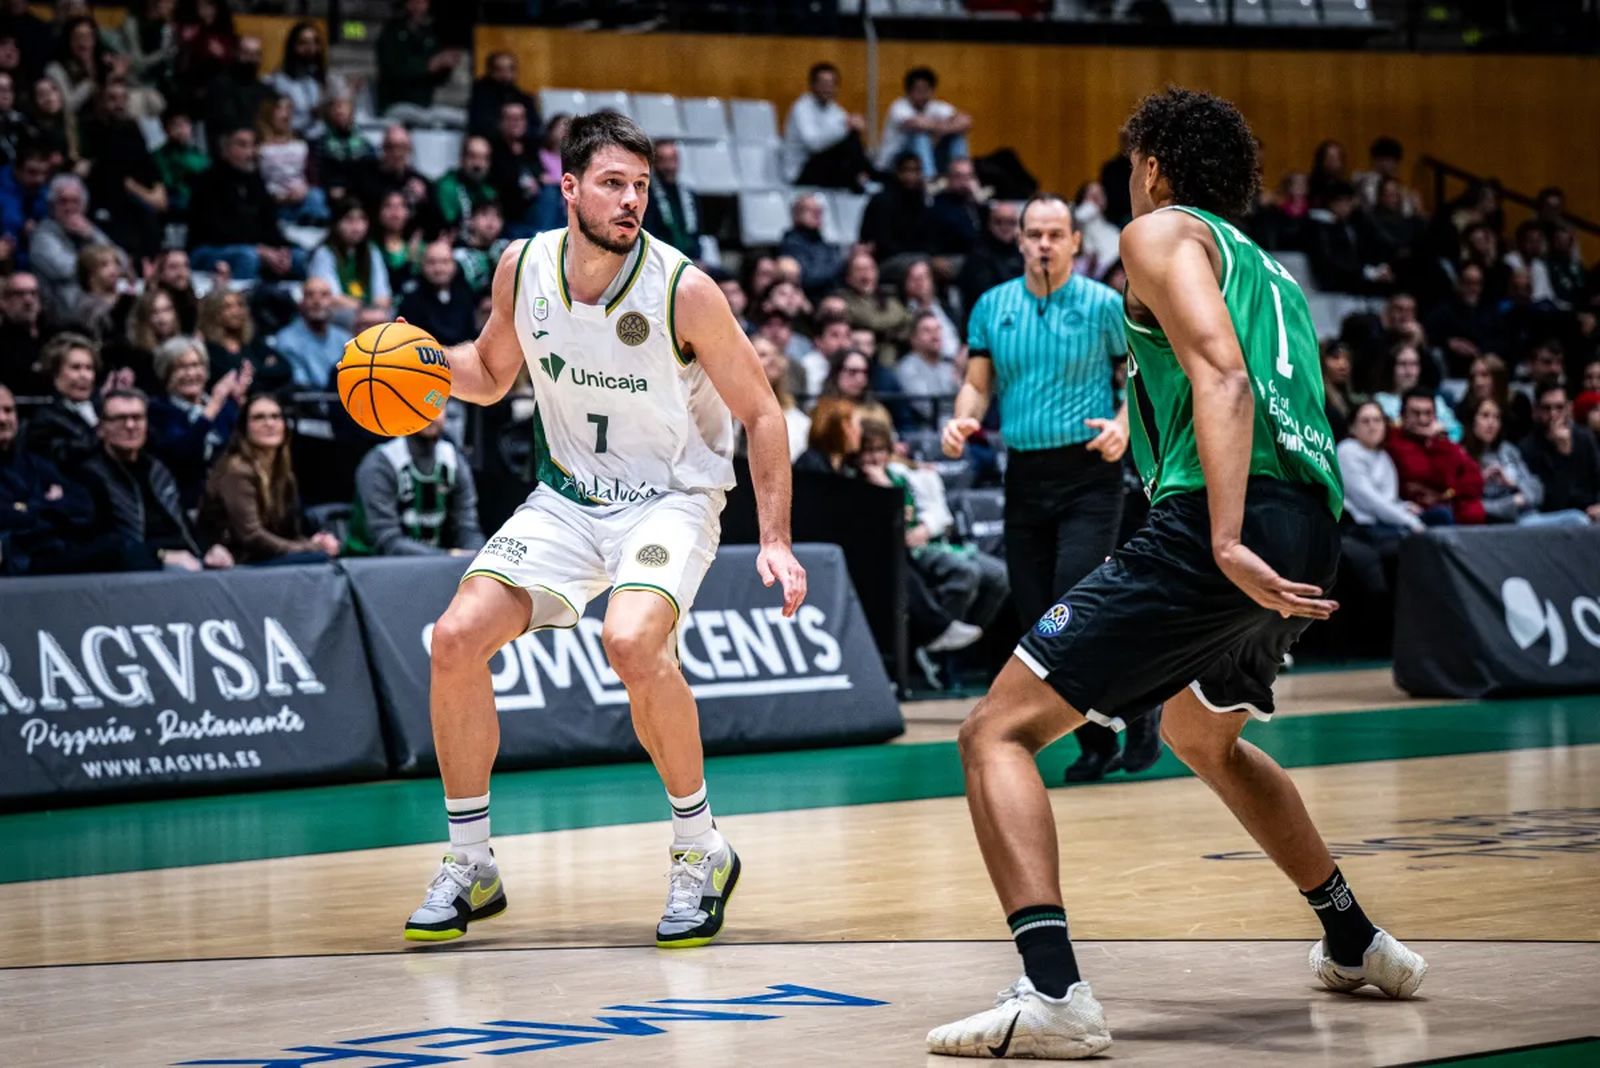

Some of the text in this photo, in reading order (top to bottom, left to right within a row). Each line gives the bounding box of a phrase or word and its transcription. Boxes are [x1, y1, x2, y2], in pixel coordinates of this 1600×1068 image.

[1269, 281, 1294, 380] 1
[571, 367, 648, 393] Unicaja
[587, 413, 609, 454] 7
[492, 536, 528, 555] COSTA
[506, 546, 524, 561] SOL
[20, 705, 304, 755] Pizzería Restaurante
[82, 750, 262, 779] WWW.RAGVSA.ES
